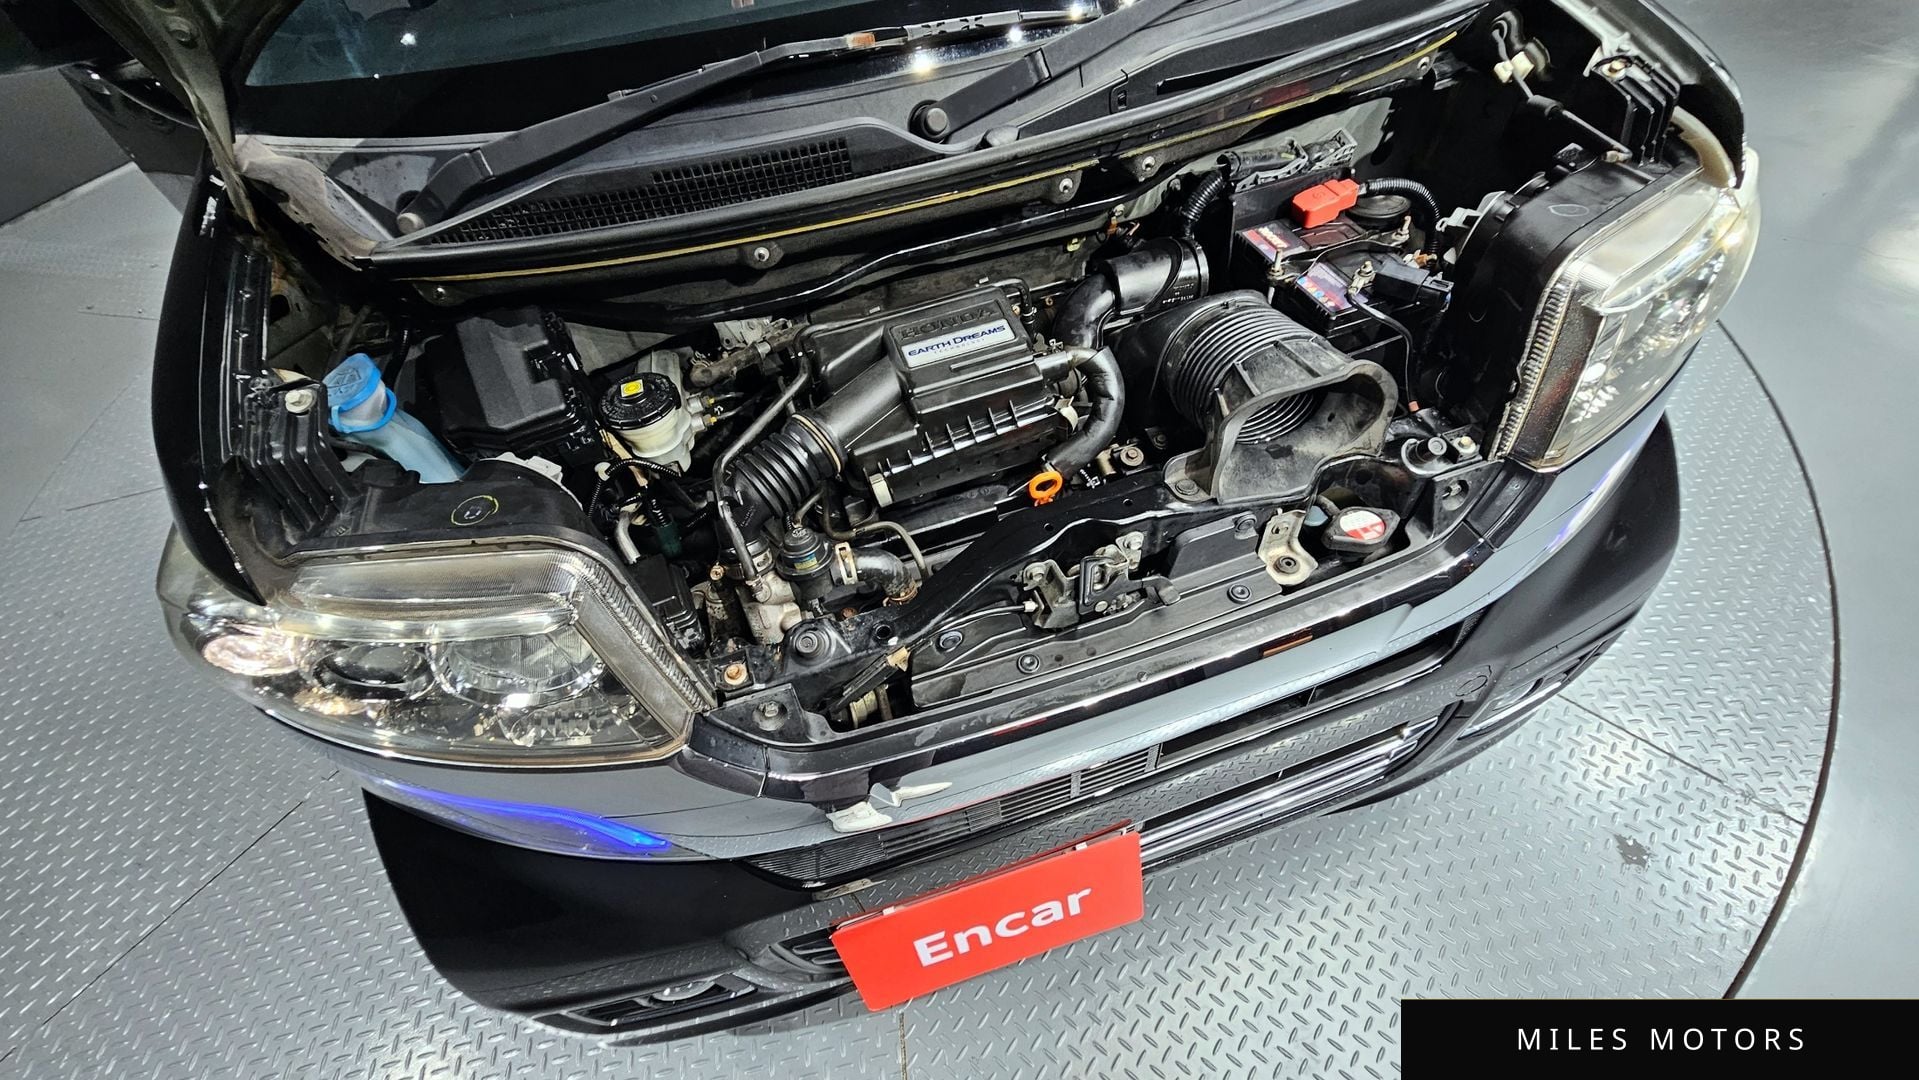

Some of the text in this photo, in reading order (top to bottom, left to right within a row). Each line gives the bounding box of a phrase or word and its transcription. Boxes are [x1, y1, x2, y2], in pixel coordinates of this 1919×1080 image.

[908, 325, 1006, 357] EARTH DREAMS
[913, 887, 1092, 967] Encar
